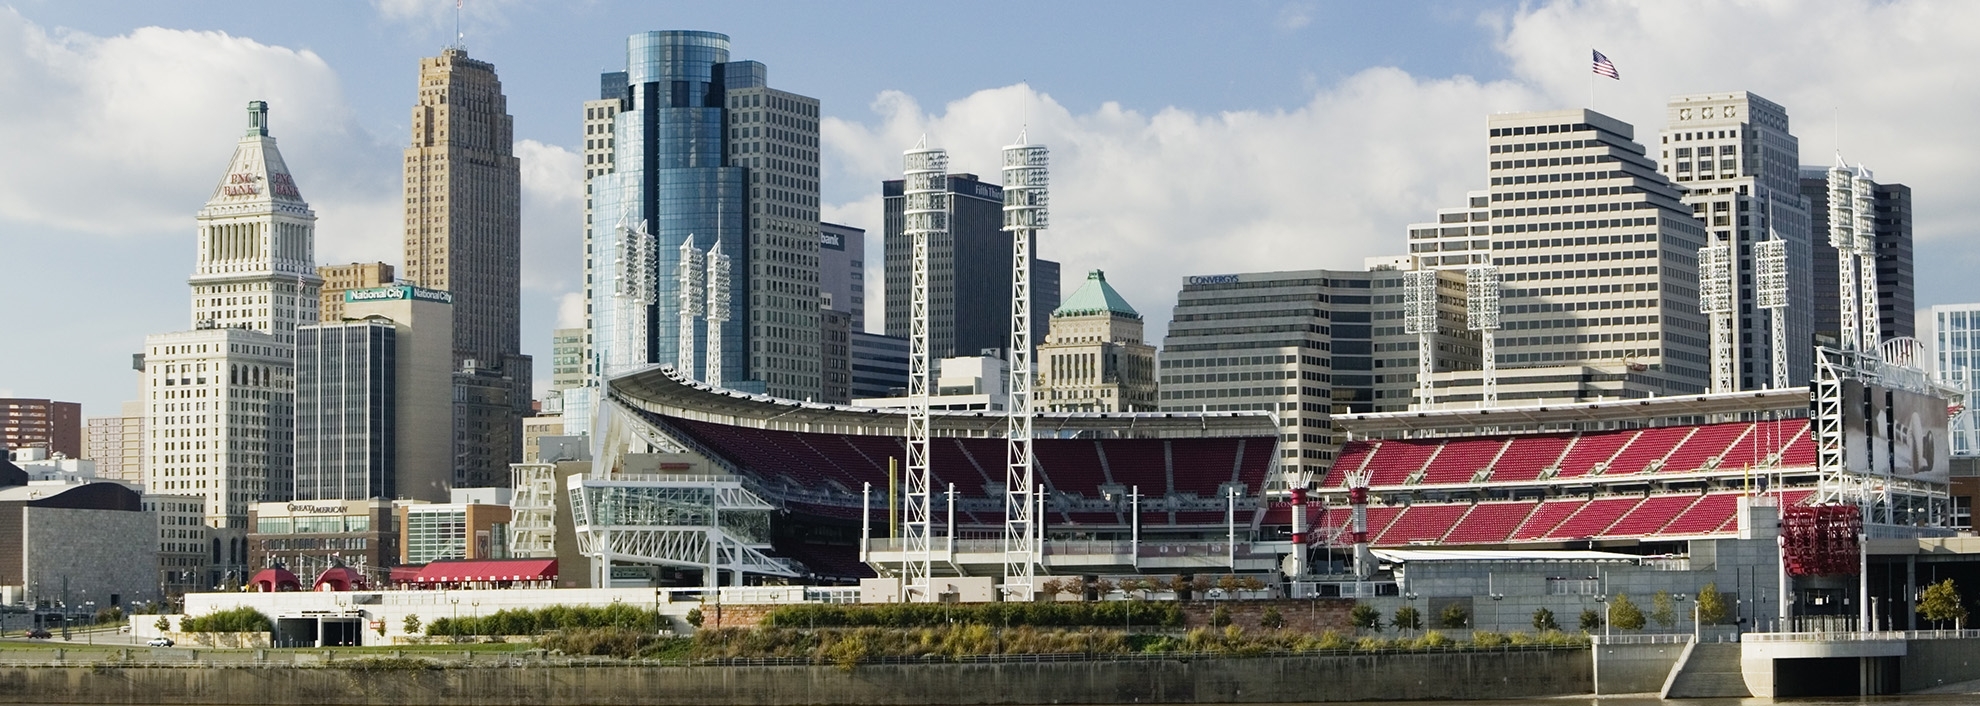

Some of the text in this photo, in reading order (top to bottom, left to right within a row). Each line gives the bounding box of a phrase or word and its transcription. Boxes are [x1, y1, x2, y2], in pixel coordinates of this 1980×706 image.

[230, 173, 253, 184] PNC
[274, 172, 292, 184] PNC
[224, 184, 255, 196] BANK
[275, 184, 299, 197] BANK
[820, 232, 839, 246] bank
[1189, 275, 1239, 285] CONVERGYS
[351, 288, 405, 300] National City
[414, 287, 452, 303] National City
